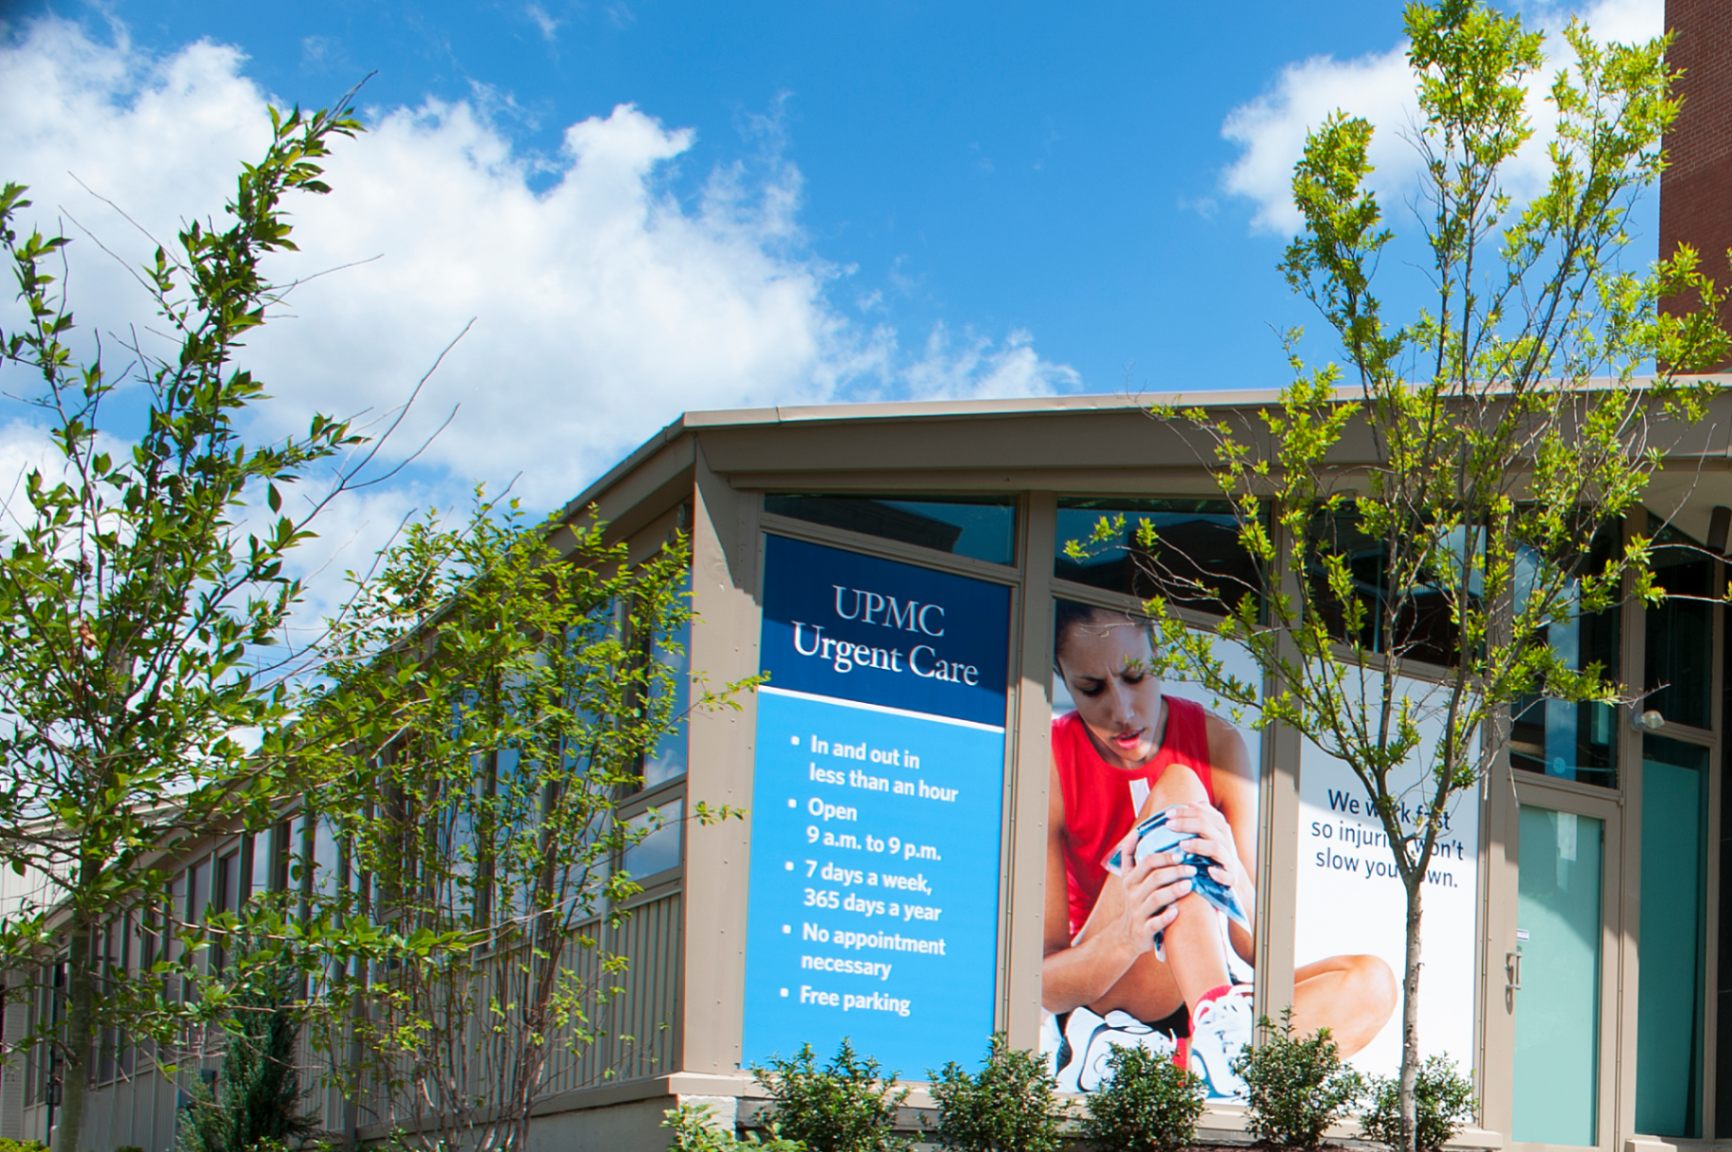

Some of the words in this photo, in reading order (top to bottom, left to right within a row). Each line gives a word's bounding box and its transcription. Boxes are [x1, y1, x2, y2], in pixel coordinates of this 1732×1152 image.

[832, 584, 945, 637] UPMC
[791, 620, 903, 673] Urgent
[909, 644, 979, 686] Care
[811, 735, 829, 754] In
[832, 742, 866, 761] and
[870, 748, 900, 766] out
[903, 750, 920, 769] in
[809, 762, 845, 785] less
[849, 769, 889, 792] than
[893, 782, 915, 796] an
[918, 780, 959, 802] hour
[807, 797, 857, 821] Open
[1328, 788, 1360, 815] We
[1365, 801, 1410, 824] wk
[806, 825, 820, 844] 9
[823, 831, 862, 850] a.m.
[866, 834, 884, 853] to
[888, 837, 901, 855] 9
[904, 842, 942, 861] p.m.
[1312, 821, 1333, 839] so
[1339, 820, 1389, 849] injuri
[805, 860, 818, 878] 7
[821, 862, 863, 886] days
[867, 872, 878, 886] a
[882, 874, 933, 896] week,
[1316, 847, 1360, 872] slow
[1365, 859, 1399, 880] you
[803, 888, 840, 909] 365
[843, 893, 885, 917] days
[889, 903, 900, 917] a
[903, 904, 942, 922] year
[803, 922, 829, 942] No
[833, 929, 946, 955] appointment
[801, 955, 892, 981] necessary
[800, 985, 840, 1006] Free
[843, 992, 911, 1017] parking
